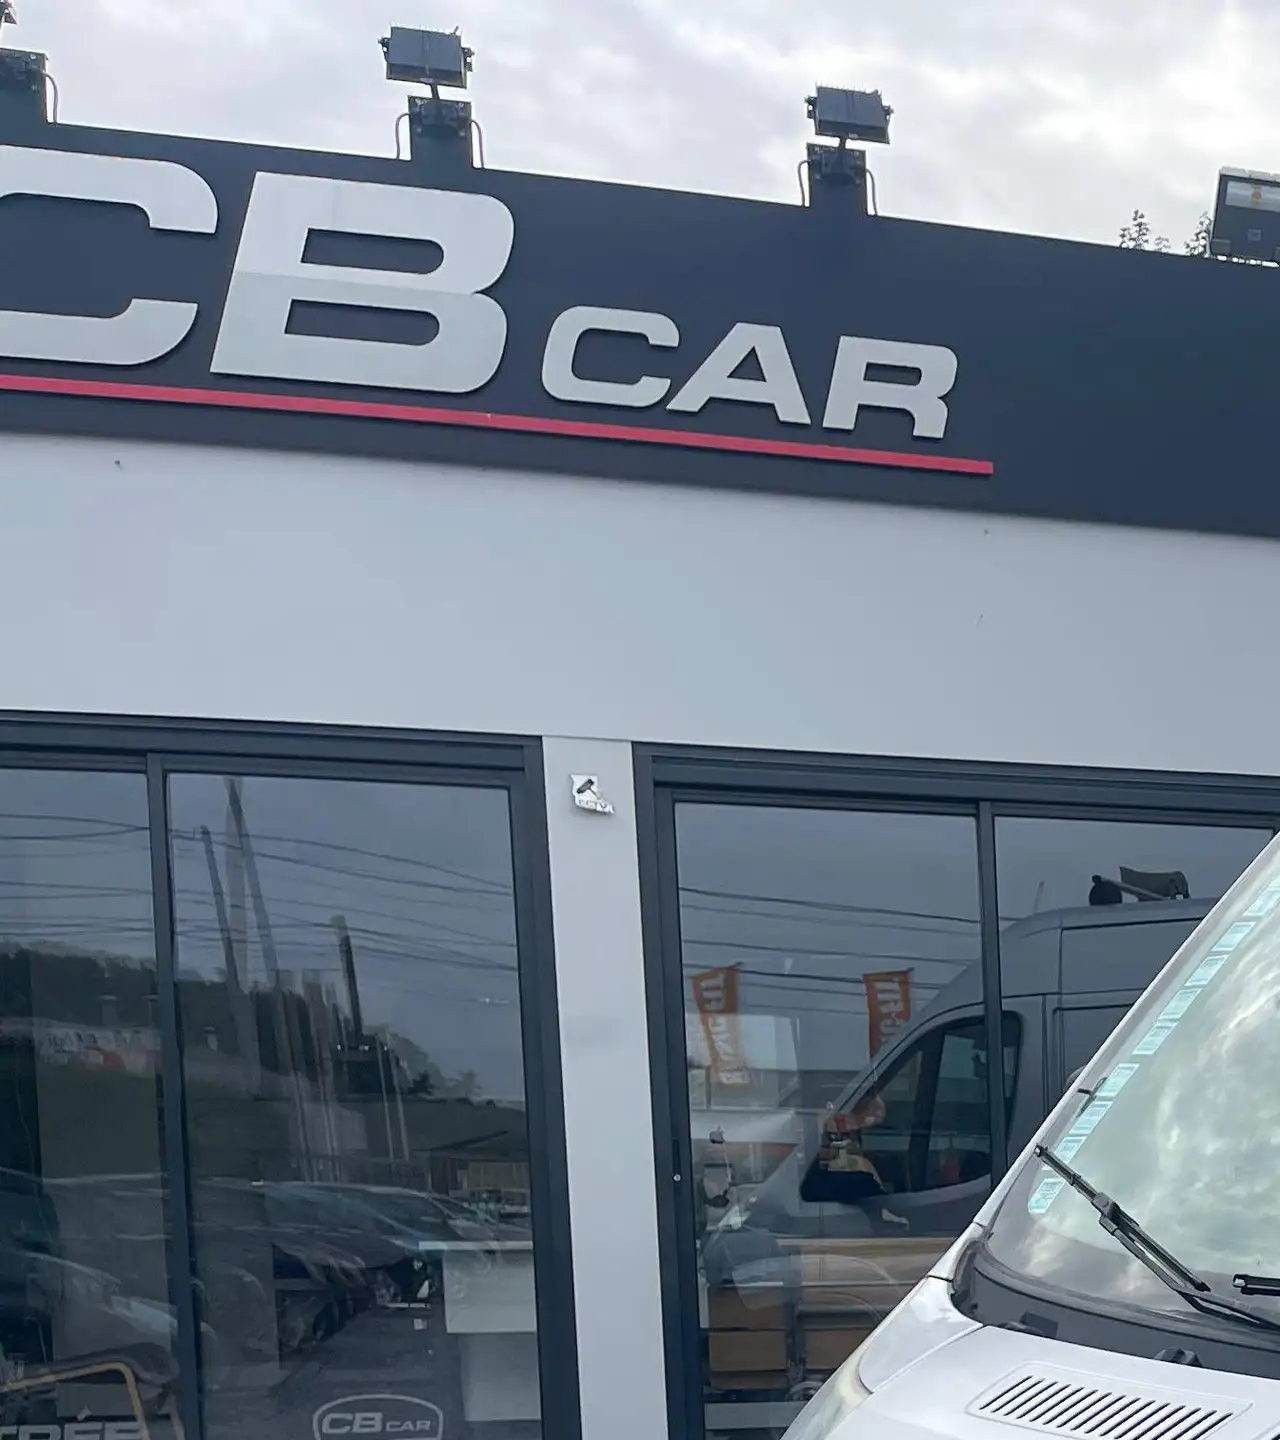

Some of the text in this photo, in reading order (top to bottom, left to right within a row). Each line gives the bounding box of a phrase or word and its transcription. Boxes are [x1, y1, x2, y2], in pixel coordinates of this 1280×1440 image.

[0, 144, 959, 440] CB CAR
[321, 1410, 432, 1435] CB CAR
